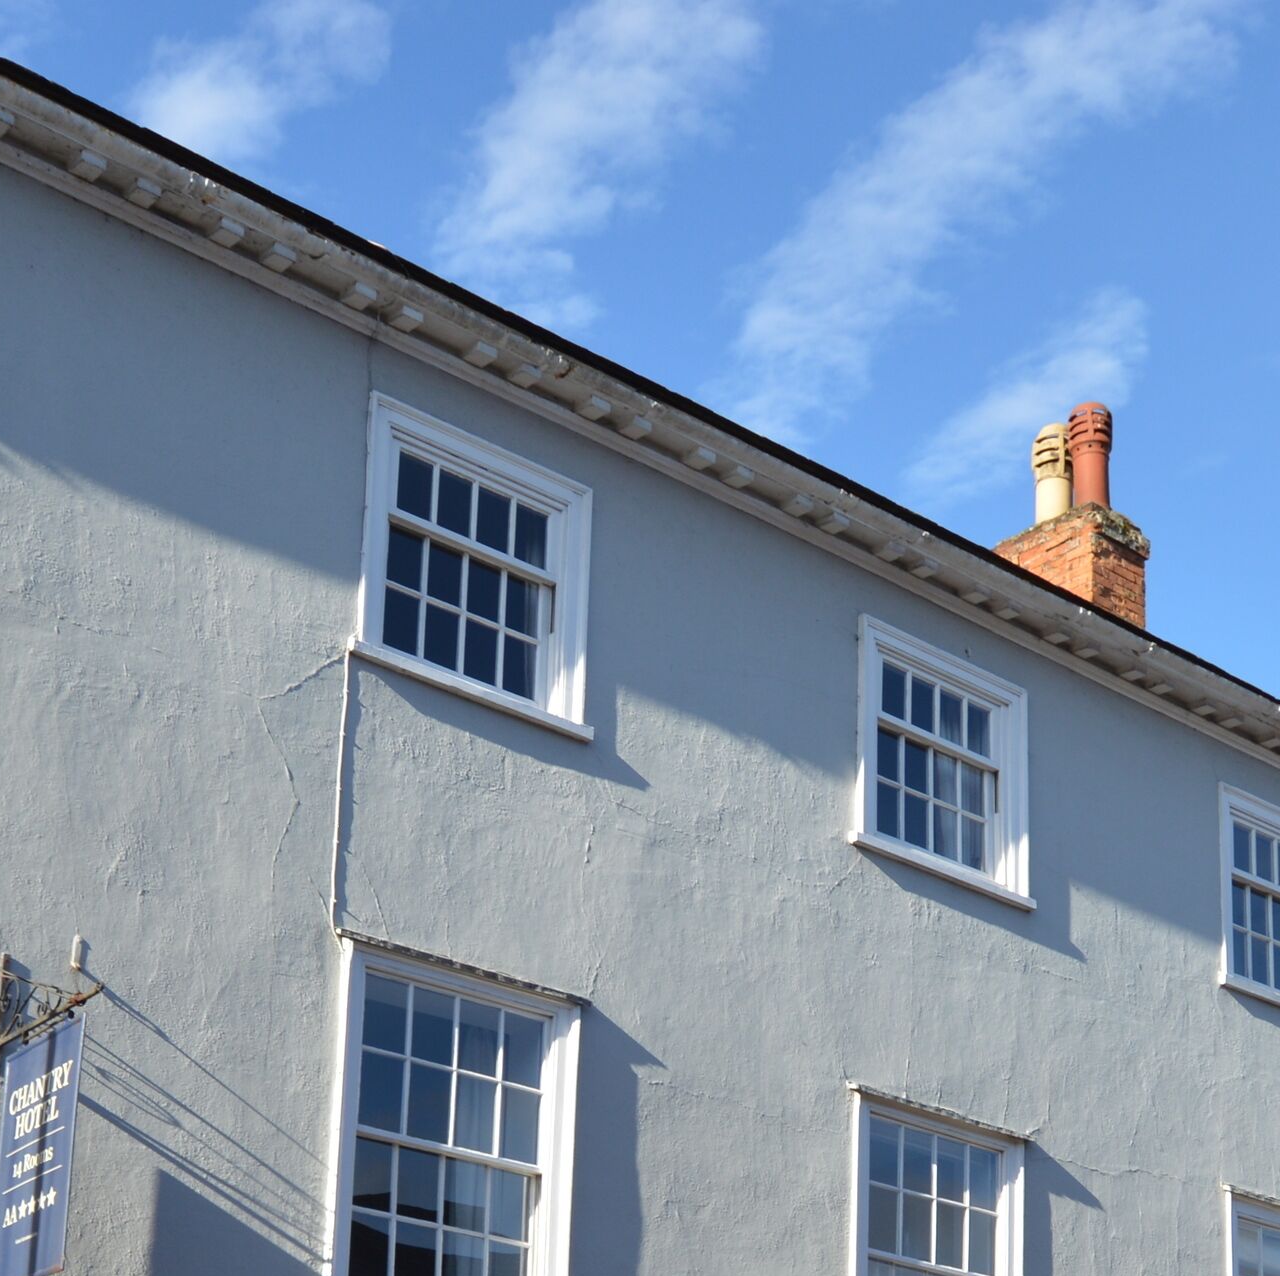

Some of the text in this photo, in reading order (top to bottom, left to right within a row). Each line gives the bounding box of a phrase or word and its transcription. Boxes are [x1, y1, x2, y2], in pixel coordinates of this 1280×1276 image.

[9, 1059, 73, 1115] CHANTRY
[14, 1095, 59, 1140] HOTEL
[12, 1146, 54, 1179] 14 Rooms
